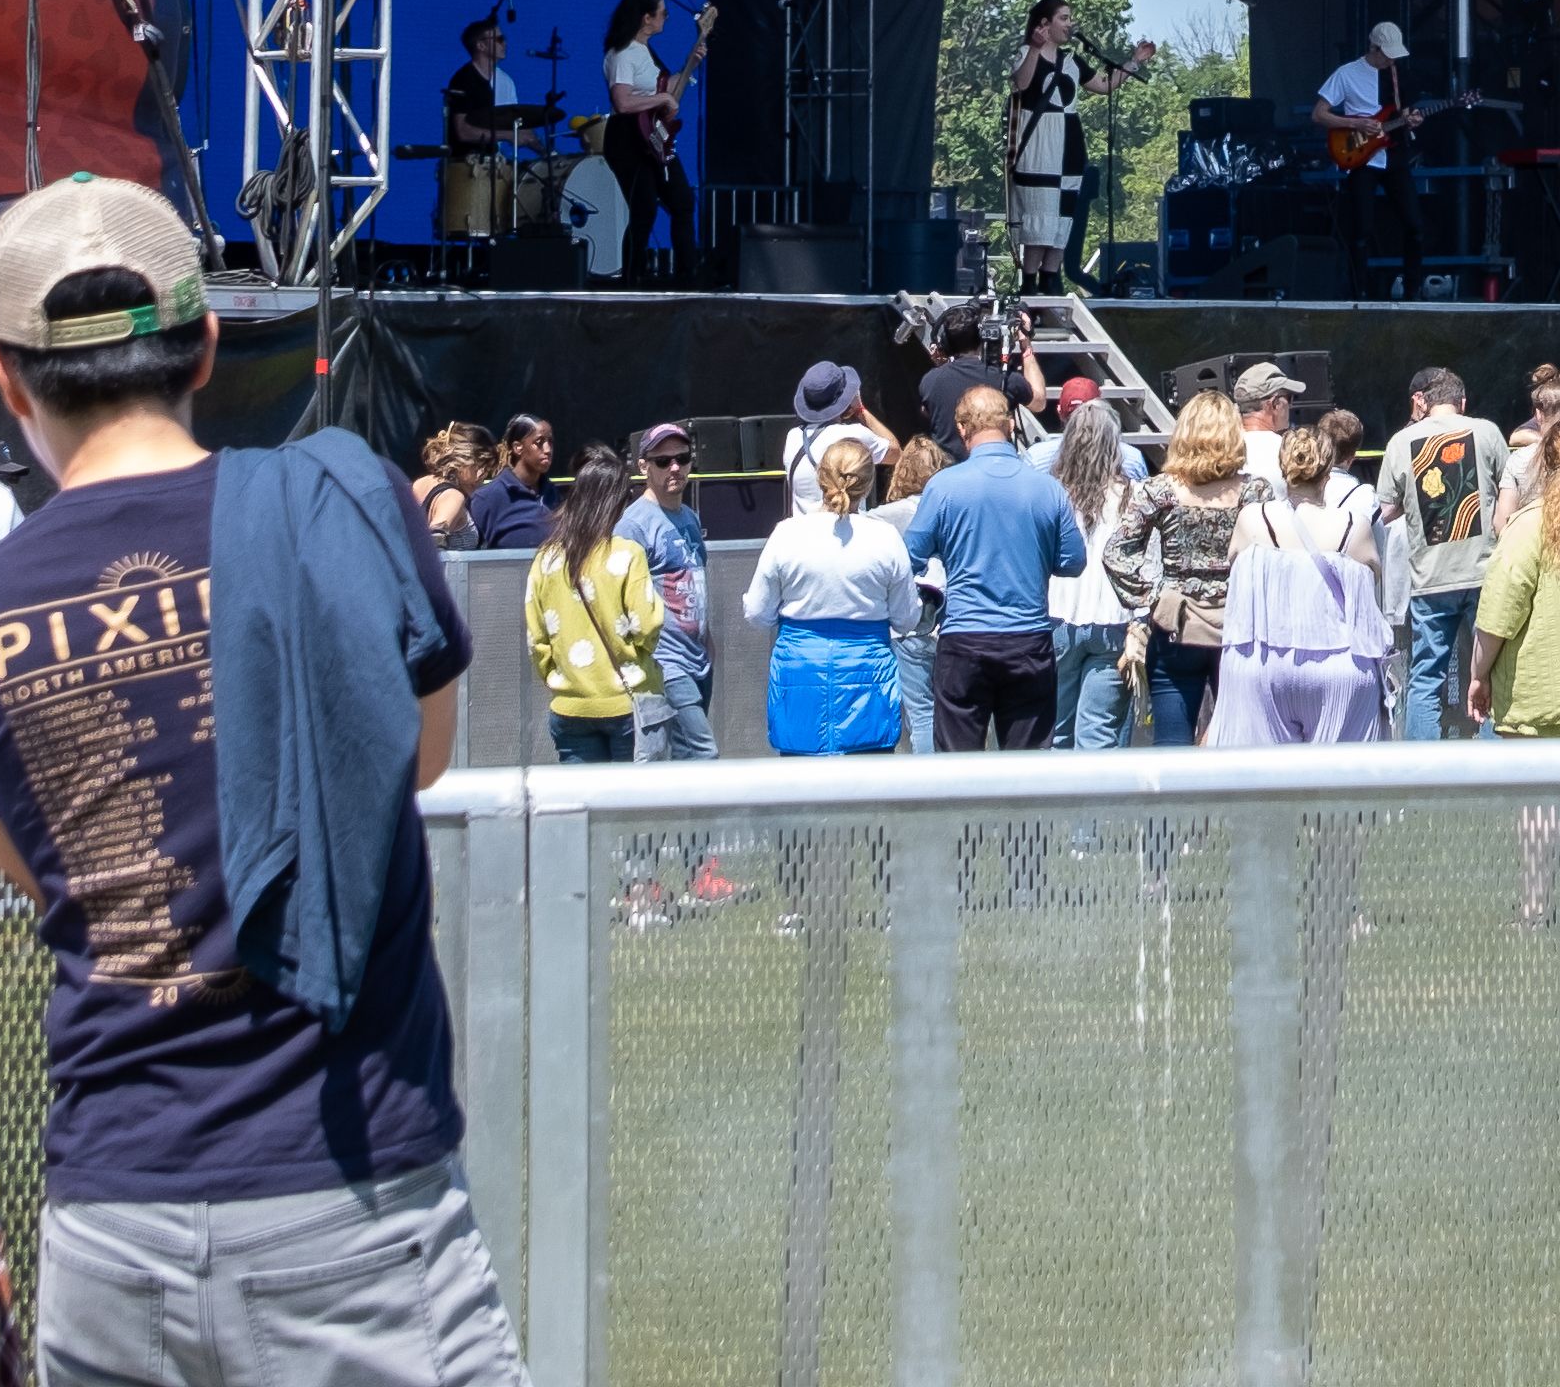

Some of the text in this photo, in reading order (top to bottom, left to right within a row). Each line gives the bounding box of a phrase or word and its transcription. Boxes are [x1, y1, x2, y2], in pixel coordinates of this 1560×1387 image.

[0, 641, 205, 706] NORTH AMERIC
[150, 985, 178, 1007] 20
